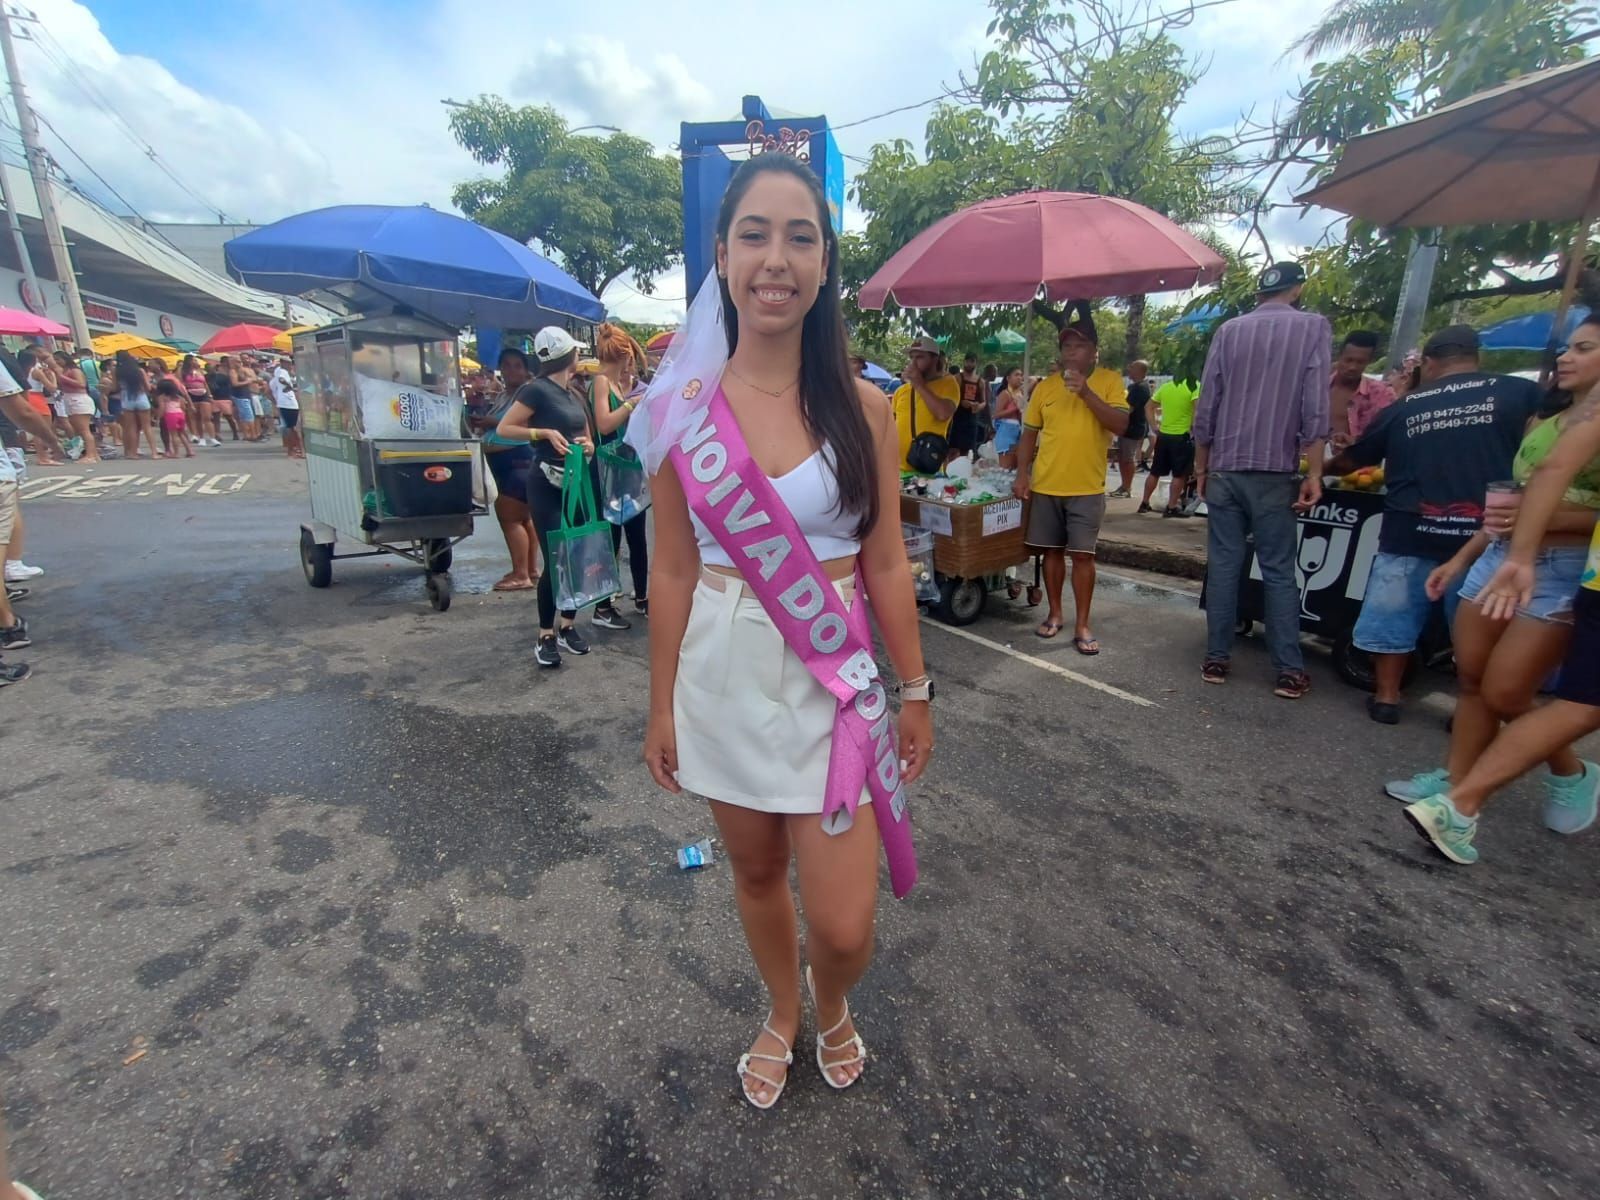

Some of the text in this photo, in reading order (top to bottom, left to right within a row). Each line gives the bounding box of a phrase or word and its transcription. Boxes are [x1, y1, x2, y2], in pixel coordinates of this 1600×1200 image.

[1406, 378, 1497, 402] Posso Ajudar ?
[399, 393, 411, 428] GELOSO
[1433, 403, 1495, 419] 9475-2248
[997, 513, 1008, 526] PIX
[1301, 502, 1358, 523] inks
[677, 405, 906, 823] NOIVA DO BONDE
